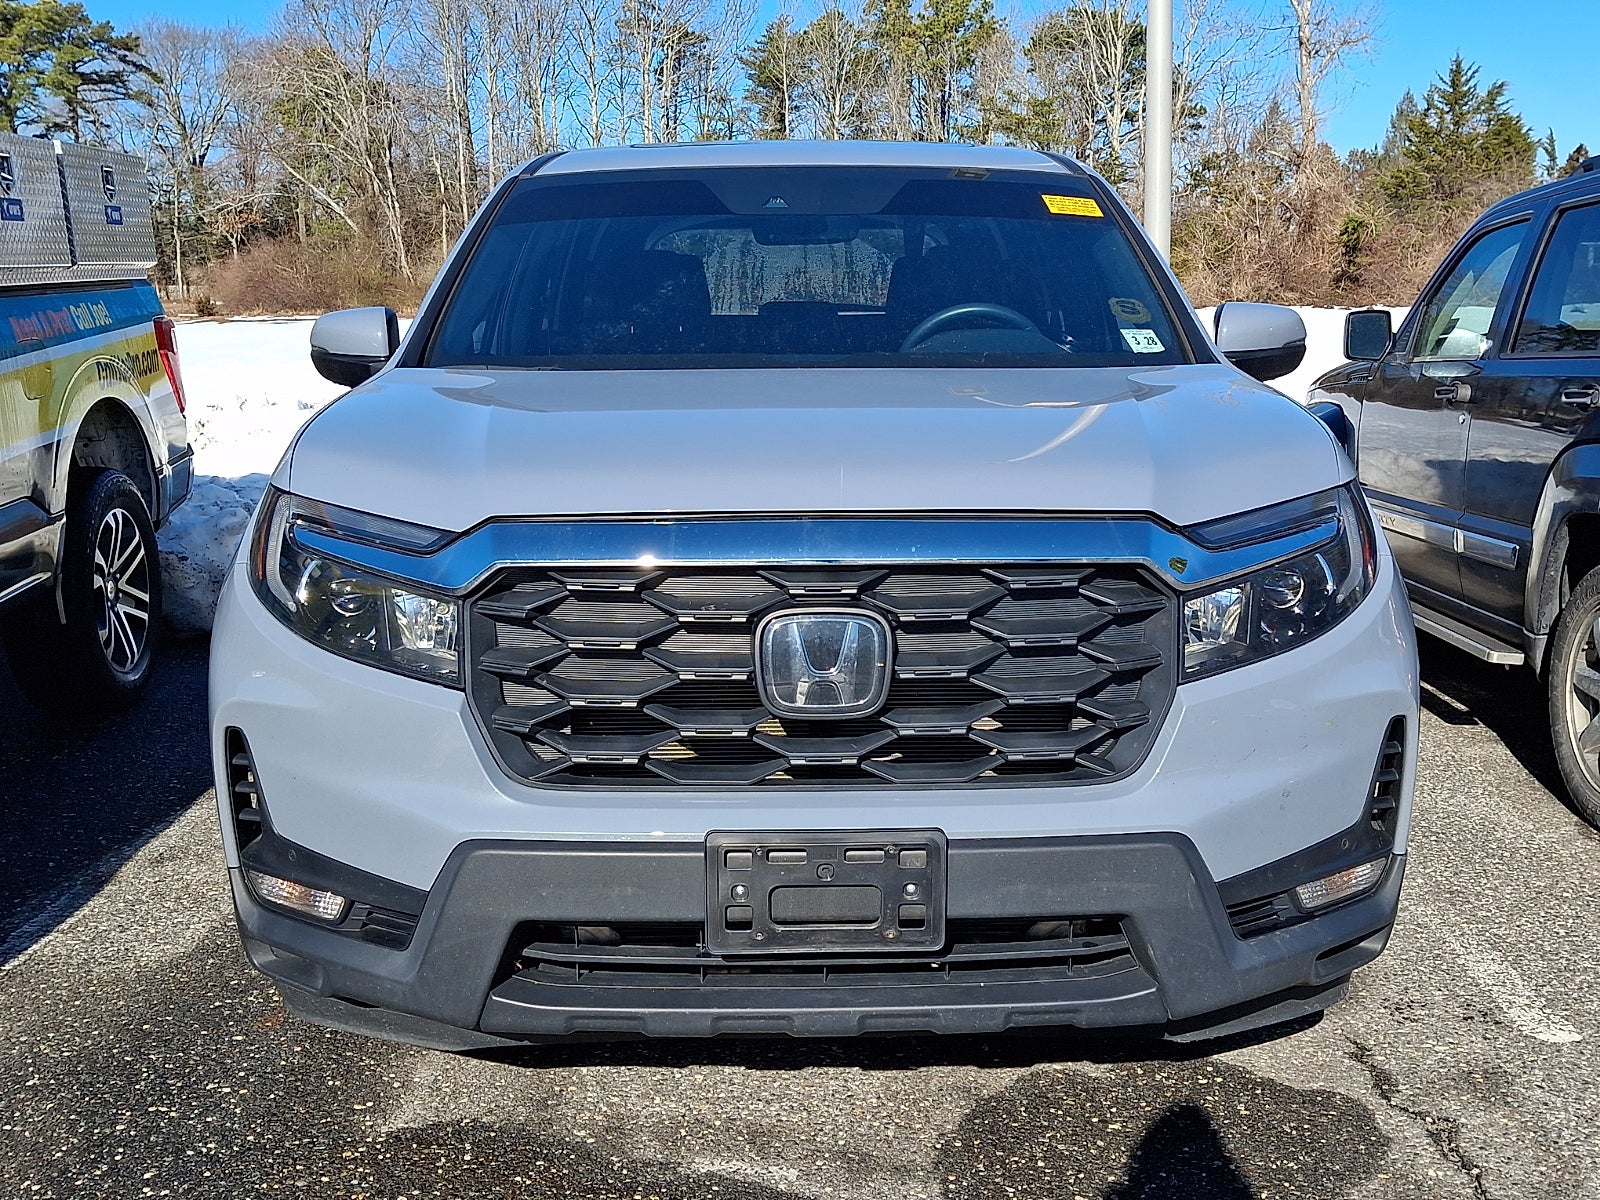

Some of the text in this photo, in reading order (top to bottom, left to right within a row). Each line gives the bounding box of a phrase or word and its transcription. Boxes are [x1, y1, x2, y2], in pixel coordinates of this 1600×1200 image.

[69, 302, 96, 331] Call
[87, 300, 113, 327] Joe!
[1144, 336, 1157, 345] 28
